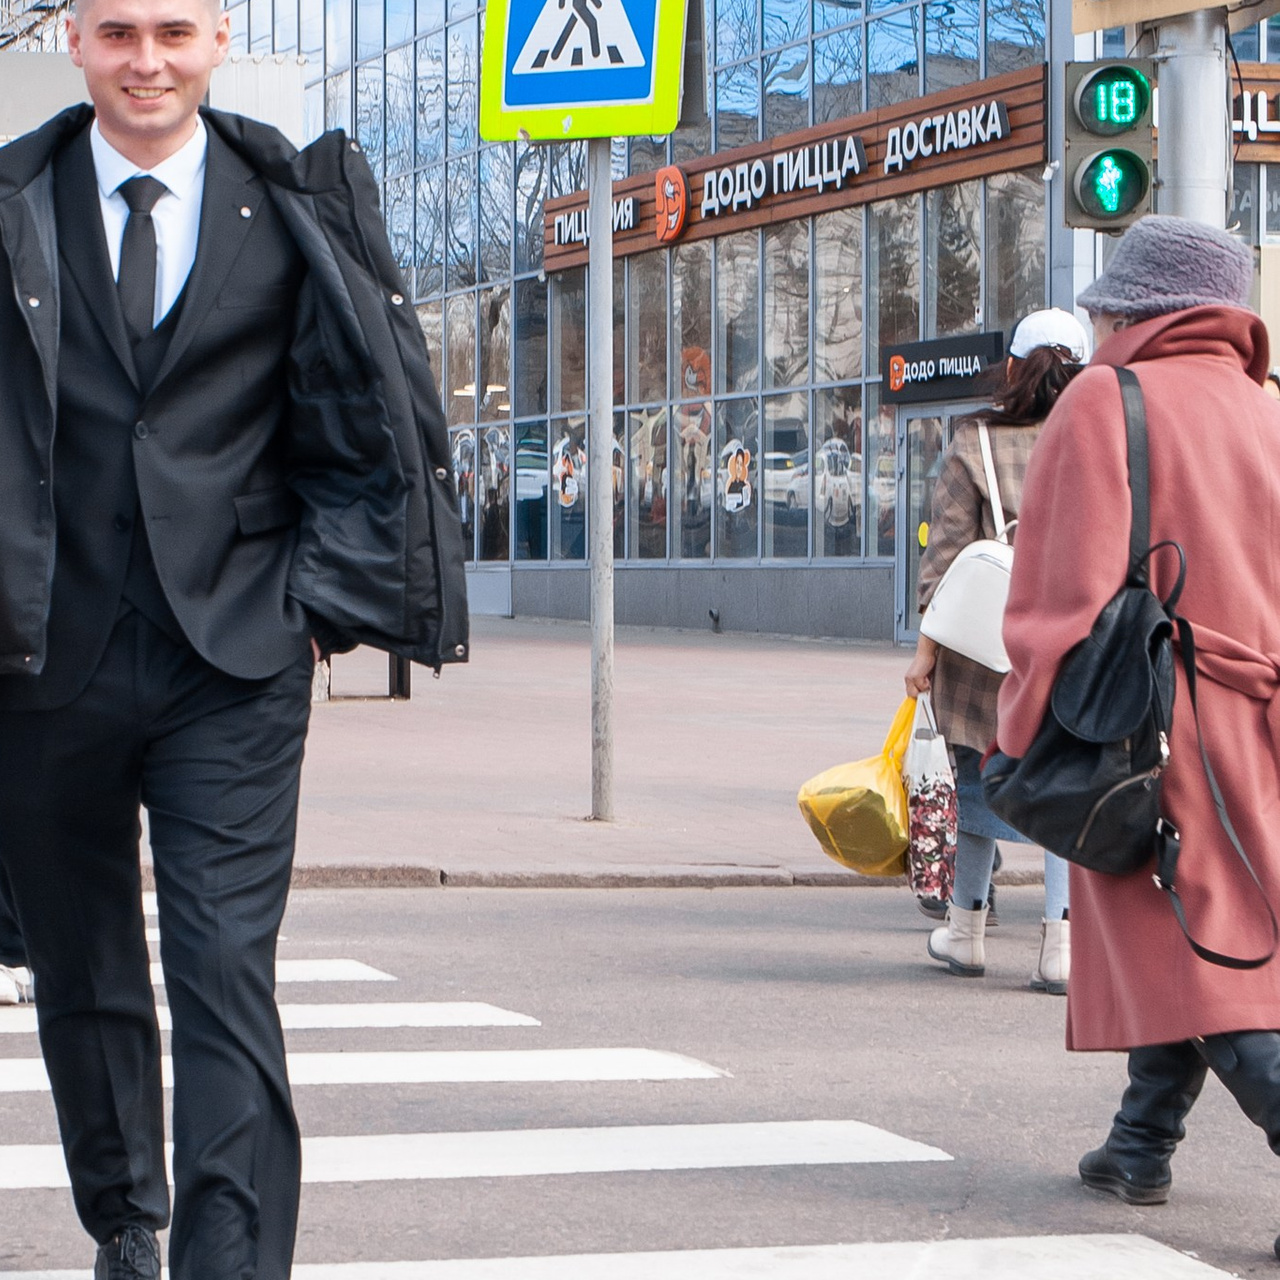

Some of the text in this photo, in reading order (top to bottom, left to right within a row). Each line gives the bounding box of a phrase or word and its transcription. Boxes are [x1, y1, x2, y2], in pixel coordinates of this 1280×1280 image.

[1096, 80, 1136, 124] 18
[554, 100, 1003, 246] ПИЦИЯ ДОДО ПИЦЦА ДОСТАВКА
[902, 355, 981, 383] ДОДО ПИЦЦА
